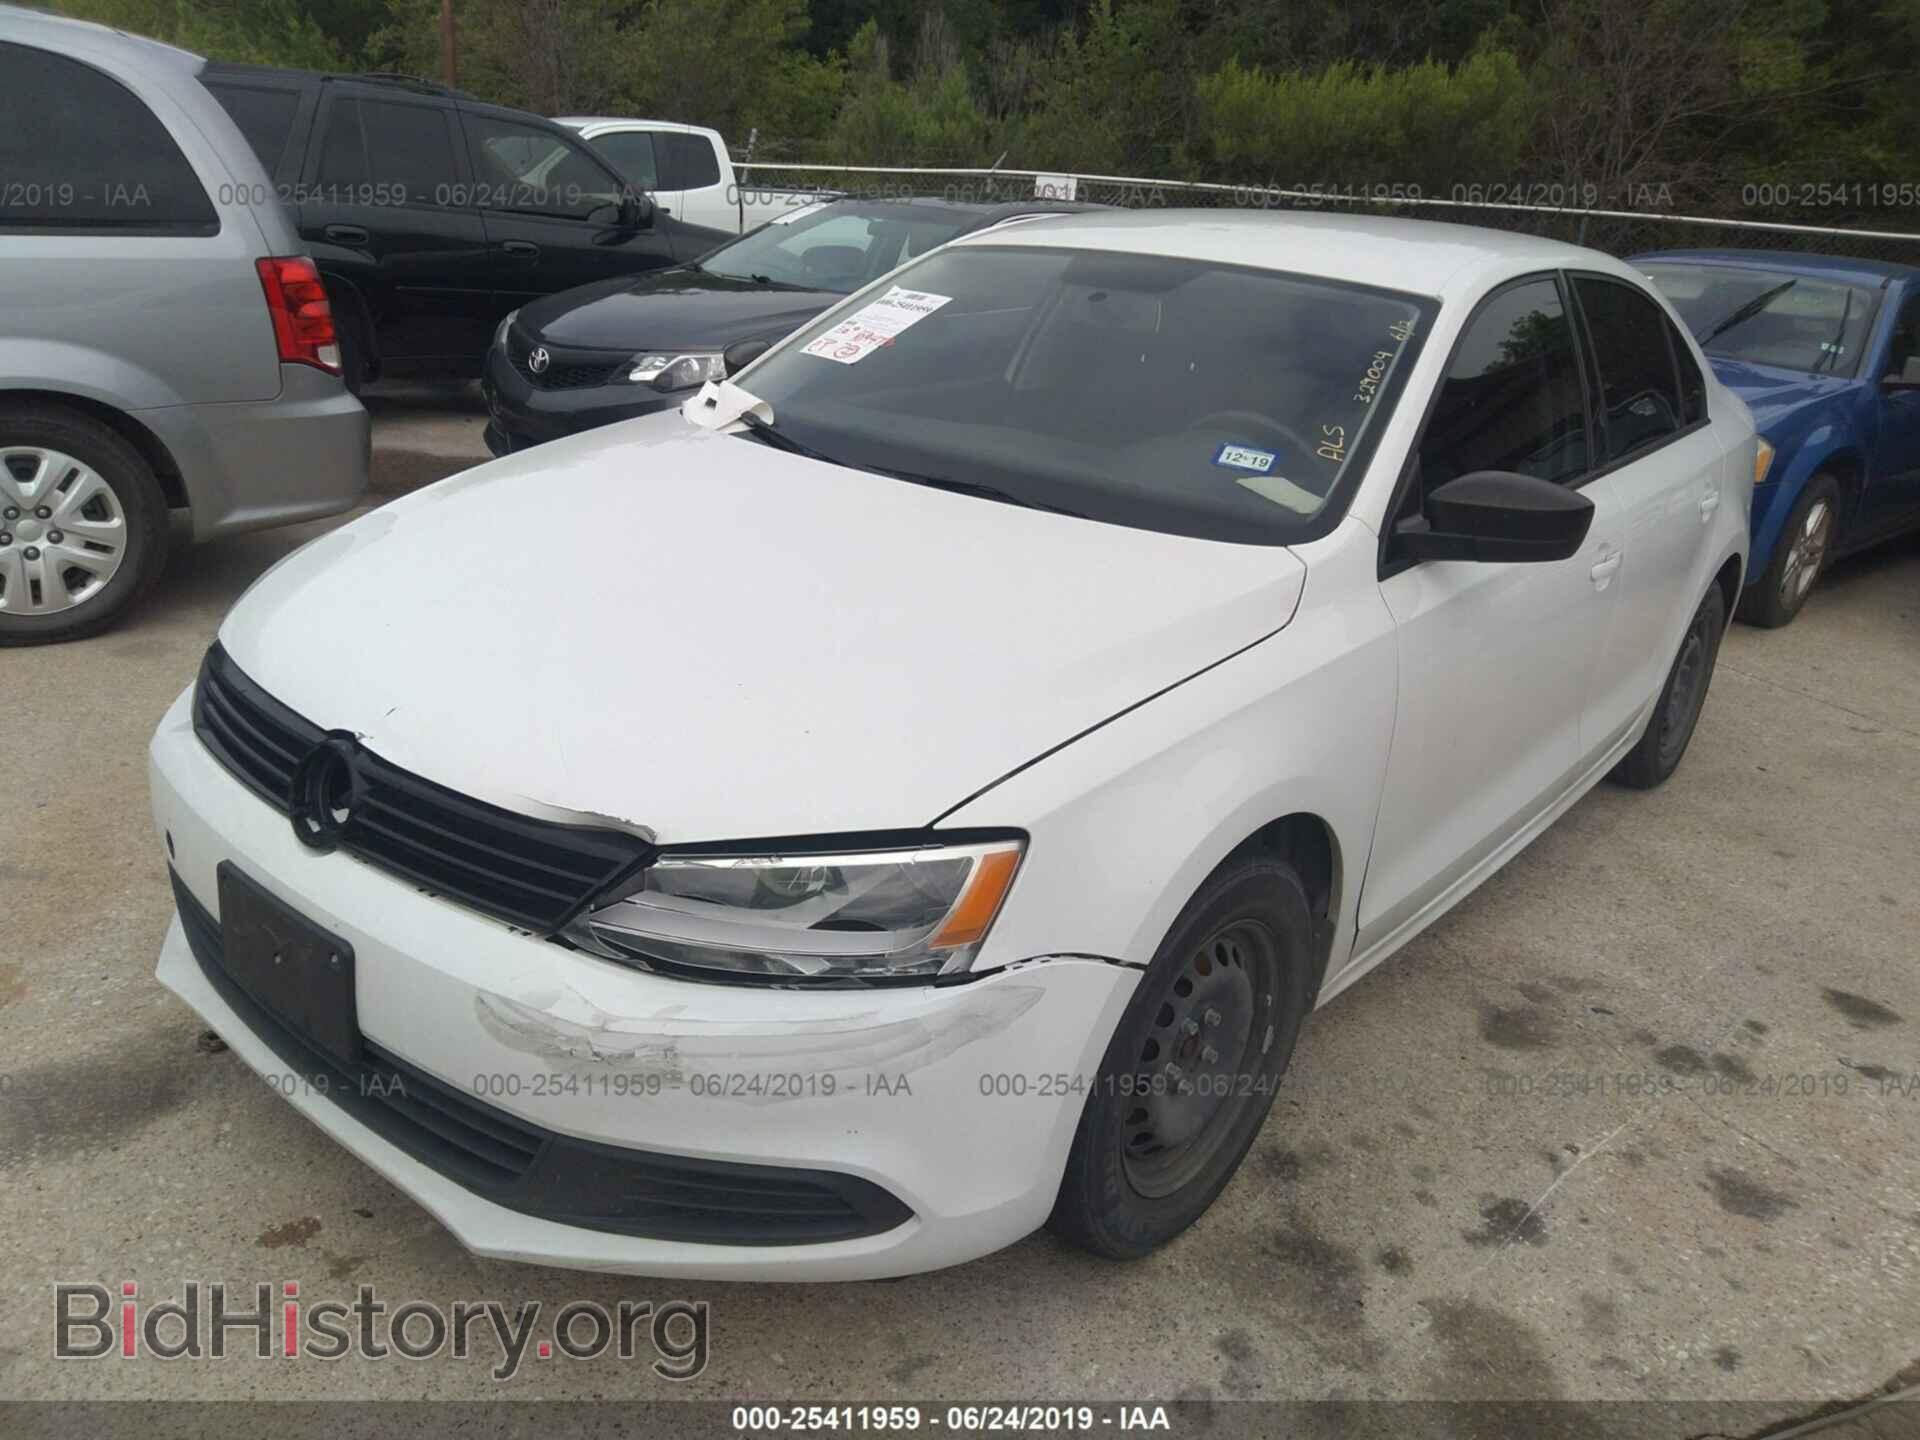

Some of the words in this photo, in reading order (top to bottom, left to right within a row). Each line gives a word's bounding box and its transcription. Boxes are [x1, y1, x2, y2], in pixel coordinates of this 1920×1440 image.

[1316, 424, 1345, 462] ALS
[1225, 451, 1243, 463] 12
[1251, 456, 1270, 468] 19
